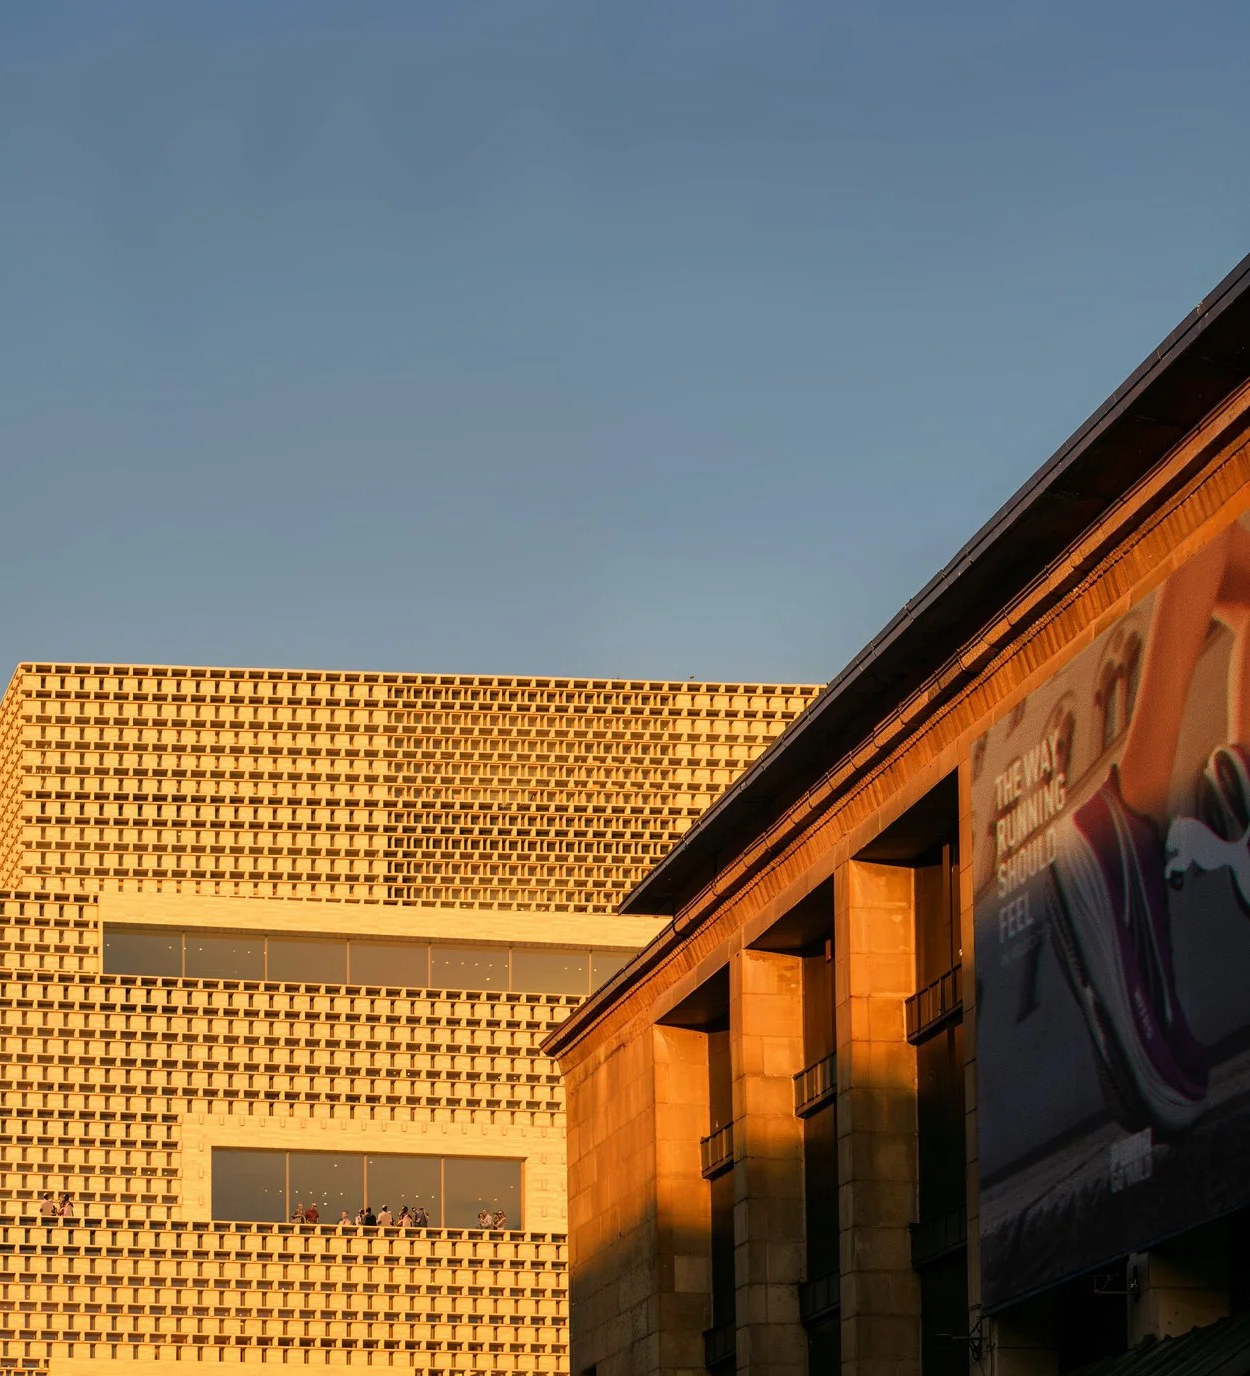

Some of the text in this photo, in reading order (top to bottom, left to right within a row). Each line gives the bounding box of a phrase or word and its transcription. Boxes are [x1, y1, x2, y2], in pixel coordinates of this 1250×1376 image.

[995, 731, 1061, 810] THE WAY
[996, 775, 1067, 860] RUNNING
[997, 827, 1057, 898] SHOULD
[999, 893, 1034, 943] FEEL
